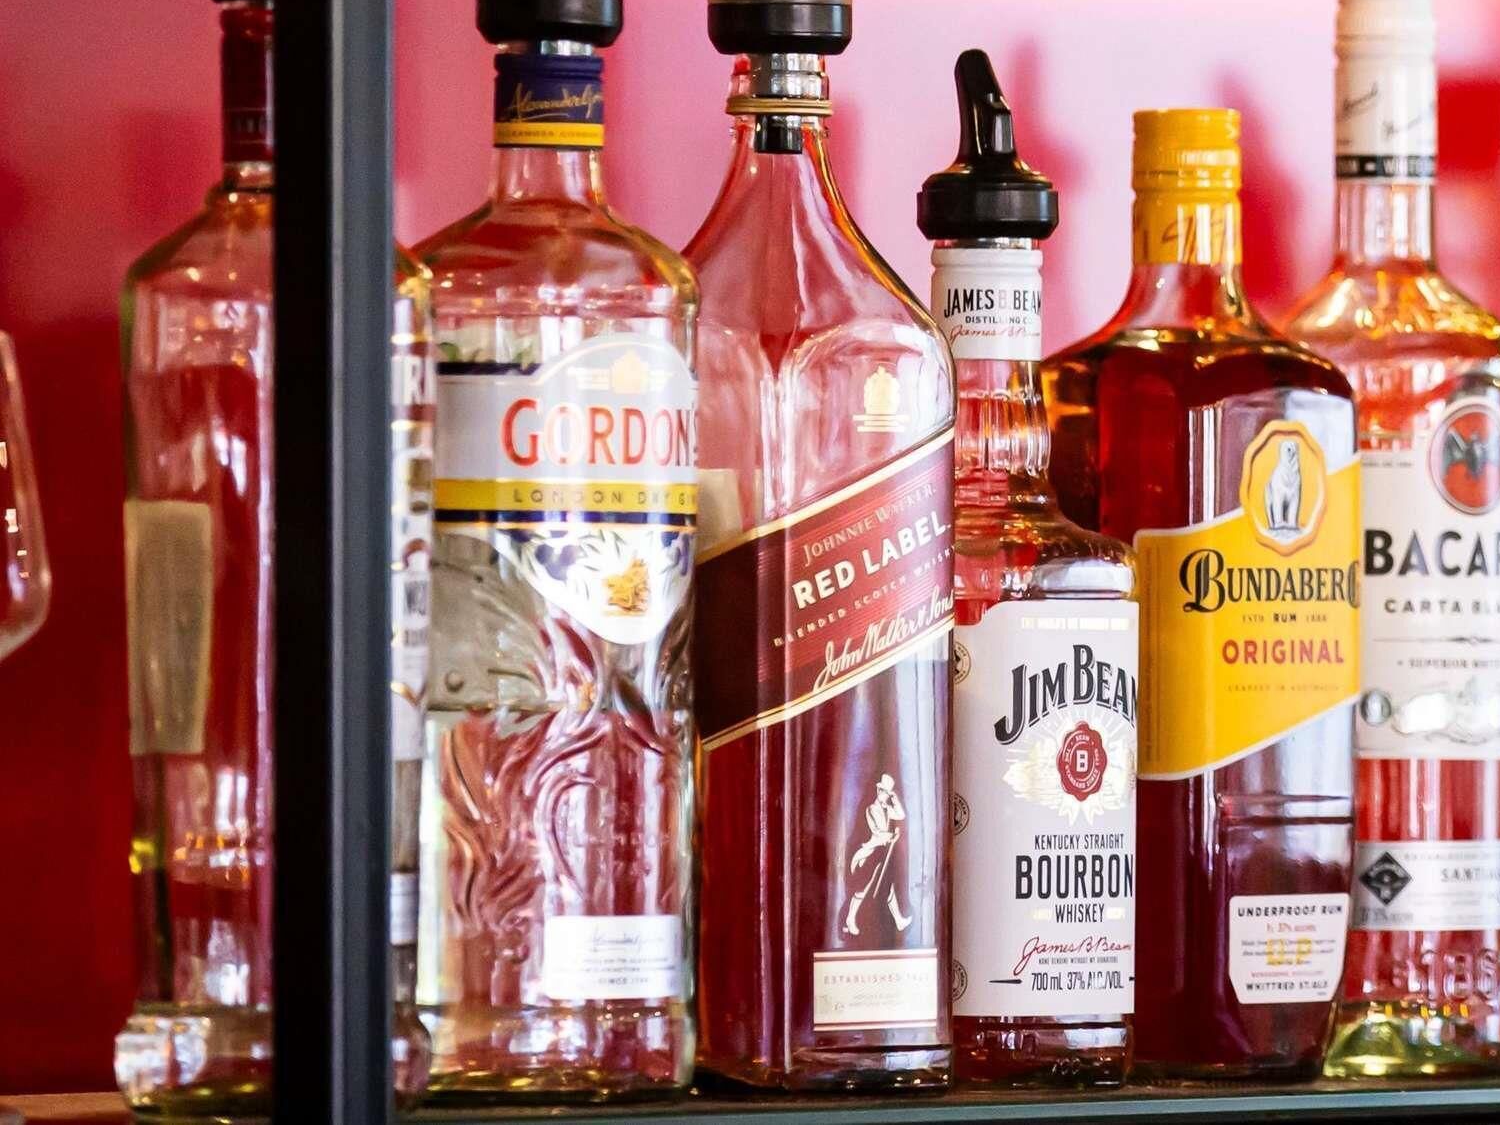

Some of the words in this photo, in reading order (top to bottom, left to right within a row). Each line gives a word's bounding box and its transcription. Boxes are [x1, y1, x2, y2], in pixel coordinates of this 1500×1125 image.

[944, 288, 995, 318] JAMES
[513, 489, 624, 504] LONDON
[802, 516, 875, 567] JOHNNIE
[791, 560, 857, 610] RED
[854, 575, 907, 610] SCOTCH
[1273, 613, 1298, 623] RUM
[1384, 599, 1462, 614] CARTA
[1221, 638, 1345, 665] ORIGINAL
[993, 661, 1067, 745] JIM
[1076, 749, 1089, 772] B
[1034, 834, 1081, 850] KENTUCKY
[1084, 833, 1124, 849] STRAIGHT
[1015, 853, 1133, 900] BOURBON
[1055, 903, 1105, 923] WHISKEY
[1237, 905, 1316, 917] UNDERPROOF
[1013, 935, 1077, 976] James
[1031, 972, 1049, 991] 700
[1067, 971, 1085, 990] 37%
